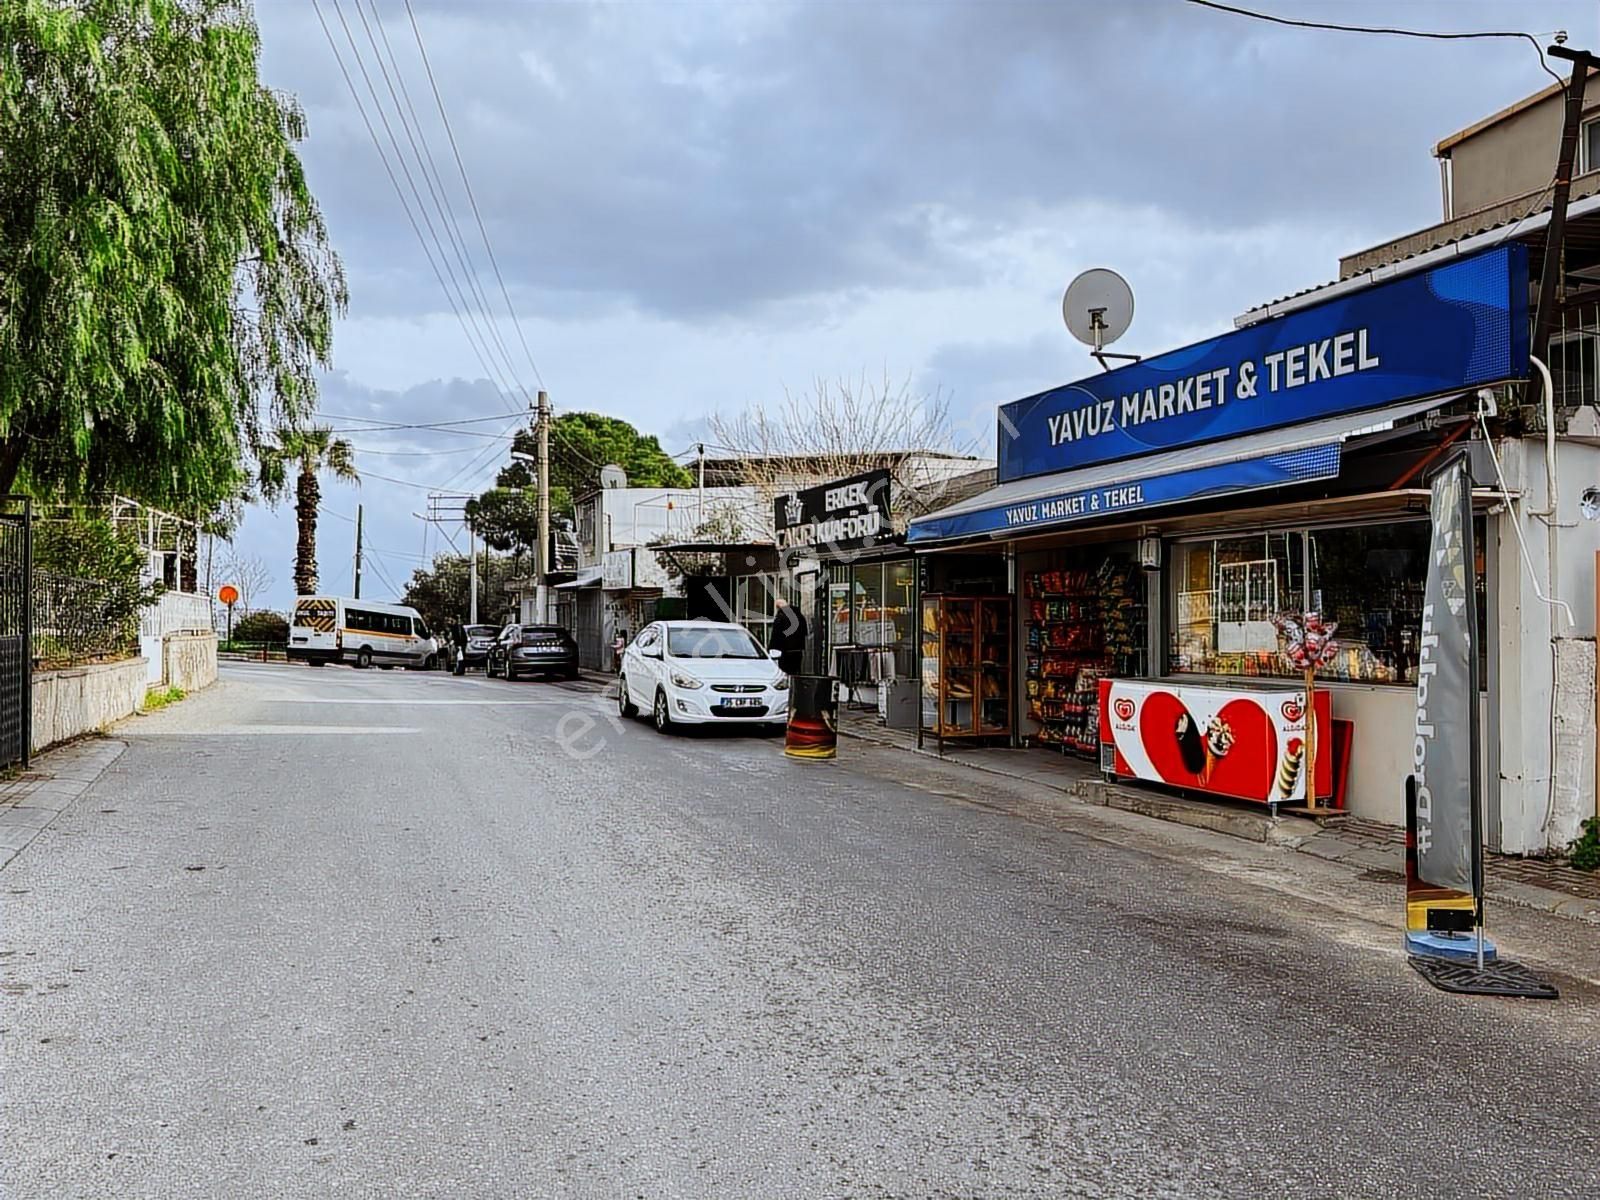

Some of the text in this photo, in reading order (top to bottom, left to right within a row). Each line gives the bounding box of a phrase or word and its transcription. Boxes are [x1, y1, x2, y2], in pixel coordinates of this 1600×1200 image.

[1047, 328, 1379, 446] YAVUZ MARKET & TEKEL
[825, 481, 869, 512] ERKEK
[1006, 485, 1144, 525] YAVUZ MARKET & TEKEL
